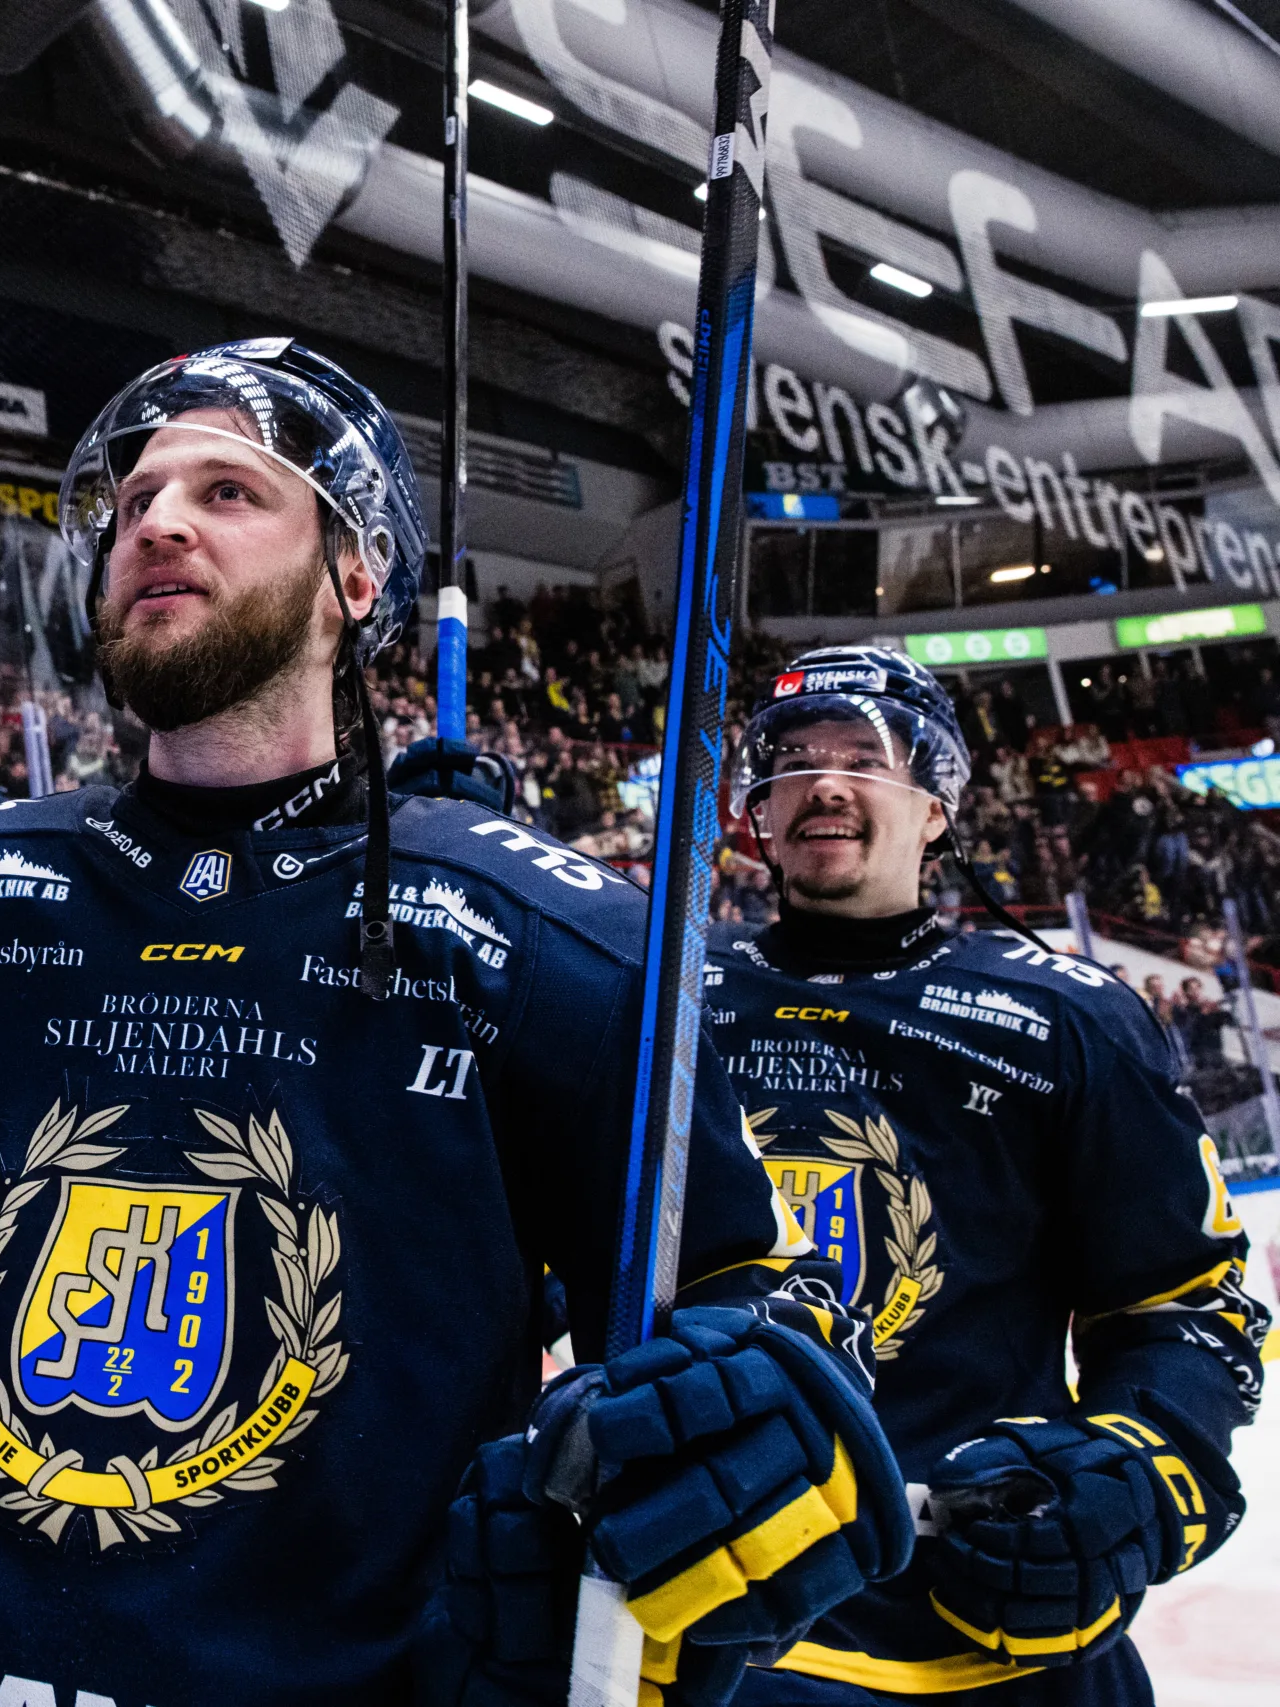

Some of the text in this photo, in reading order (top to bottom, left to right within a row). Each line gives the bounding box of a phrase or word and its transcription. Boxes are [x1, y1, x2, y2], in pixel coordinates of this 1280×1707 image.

[716, 135, 730, 177] 99786832
[657, 320, 1280, 595] Sensk-entrepren
[762, 461, 848, 491] BST
[347, 496, 365, 526] CCM
[805, 681, 842, 692] SPEL
[806, 670, 877, 683] SVENSKA
[253, 762, 340, 831] CCM
[670, 574, 732, 1137] JETSPEED
[40, 883, 70, 901] AB
[401, 886, 420, 902] &
[140, 944, 246, 962] CCM
[477, 941, 508, 970] AB
[705, 973, 723, 986] AB
[924, 984, 974, 1004] STÅL &
[102, 992, 263, 1021] BRÖDERNA
[774, 1006, 850, 1022] CCM
[919, 997, 1050, 1041] BRANDTEKNIK AB
[44, 1018, 318, 1066] SILJENDAHLS
[114, 1051, 230, 1078] MÅLERI
[406, 1044, 478, 1100] LT
[720, 1056, 904, 1092] ILJENDAHLS
[828, 1187, 845, 1264] 190
[170, 1228, 210, 1393] 1902
[174, 1382, 301, 1488] SPORTKLUBB
